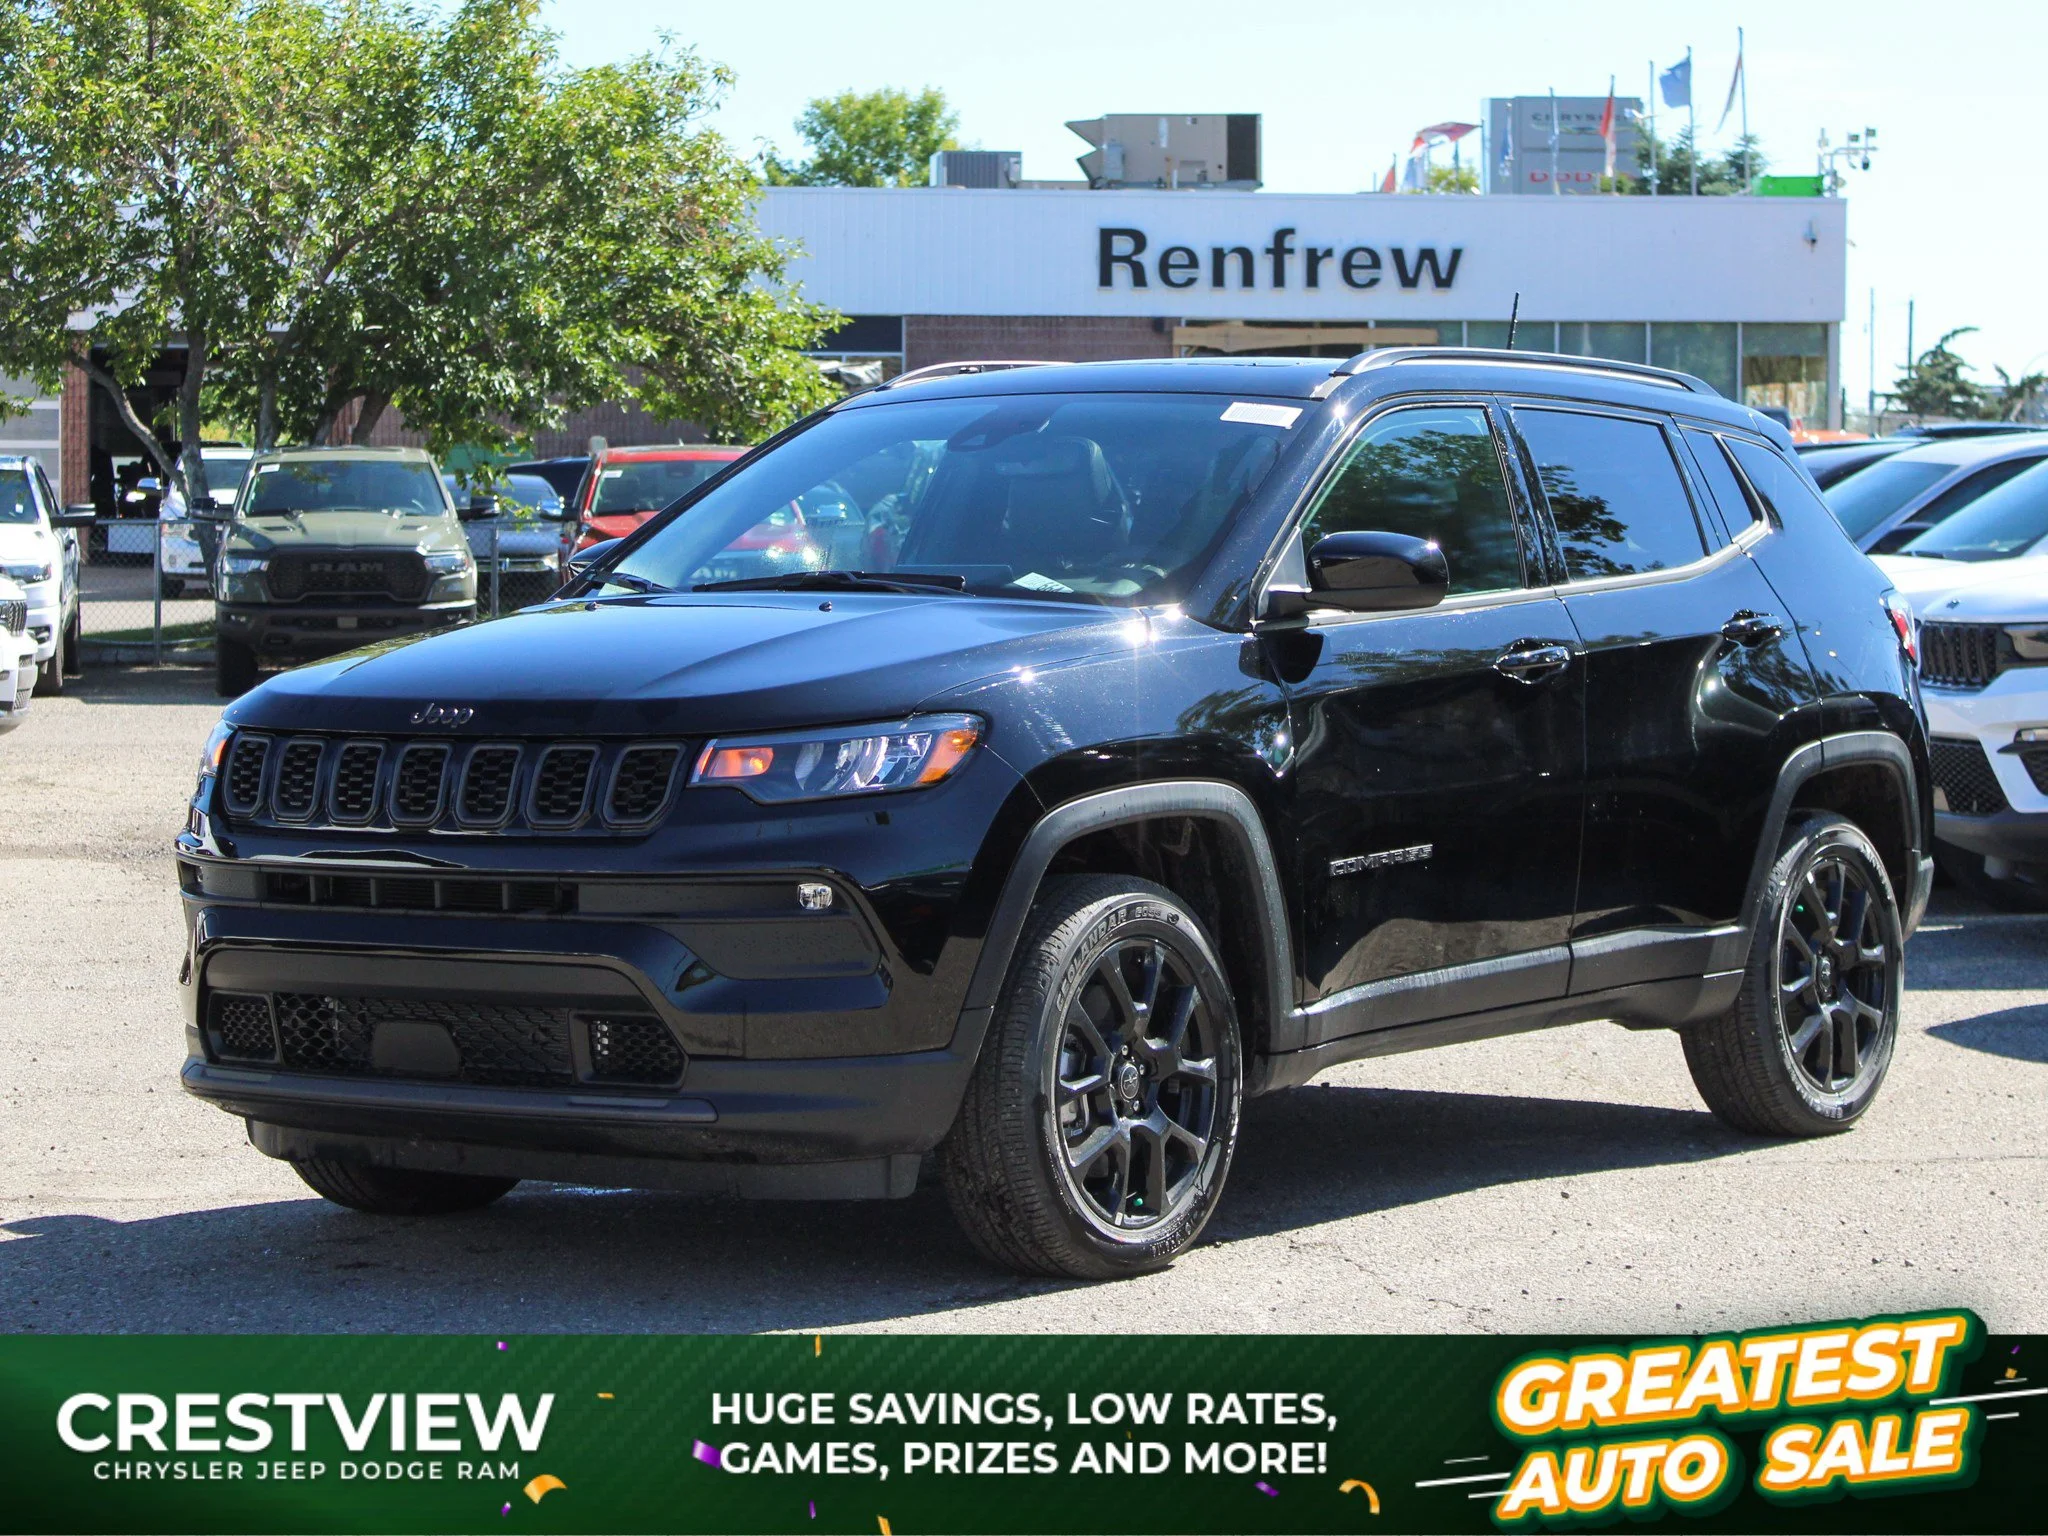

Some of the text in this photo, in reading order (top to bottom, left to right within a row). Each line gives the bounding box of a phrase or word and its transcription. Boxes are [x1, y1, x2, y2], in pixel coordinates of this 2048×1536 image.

[1098, 227, 1464, 290] Renfrew
[309, 561, 385, 573] RAM
[410, 702, 474, 728] Jeep
[1056, 908, 1127, 1012] GEOLANDAR
